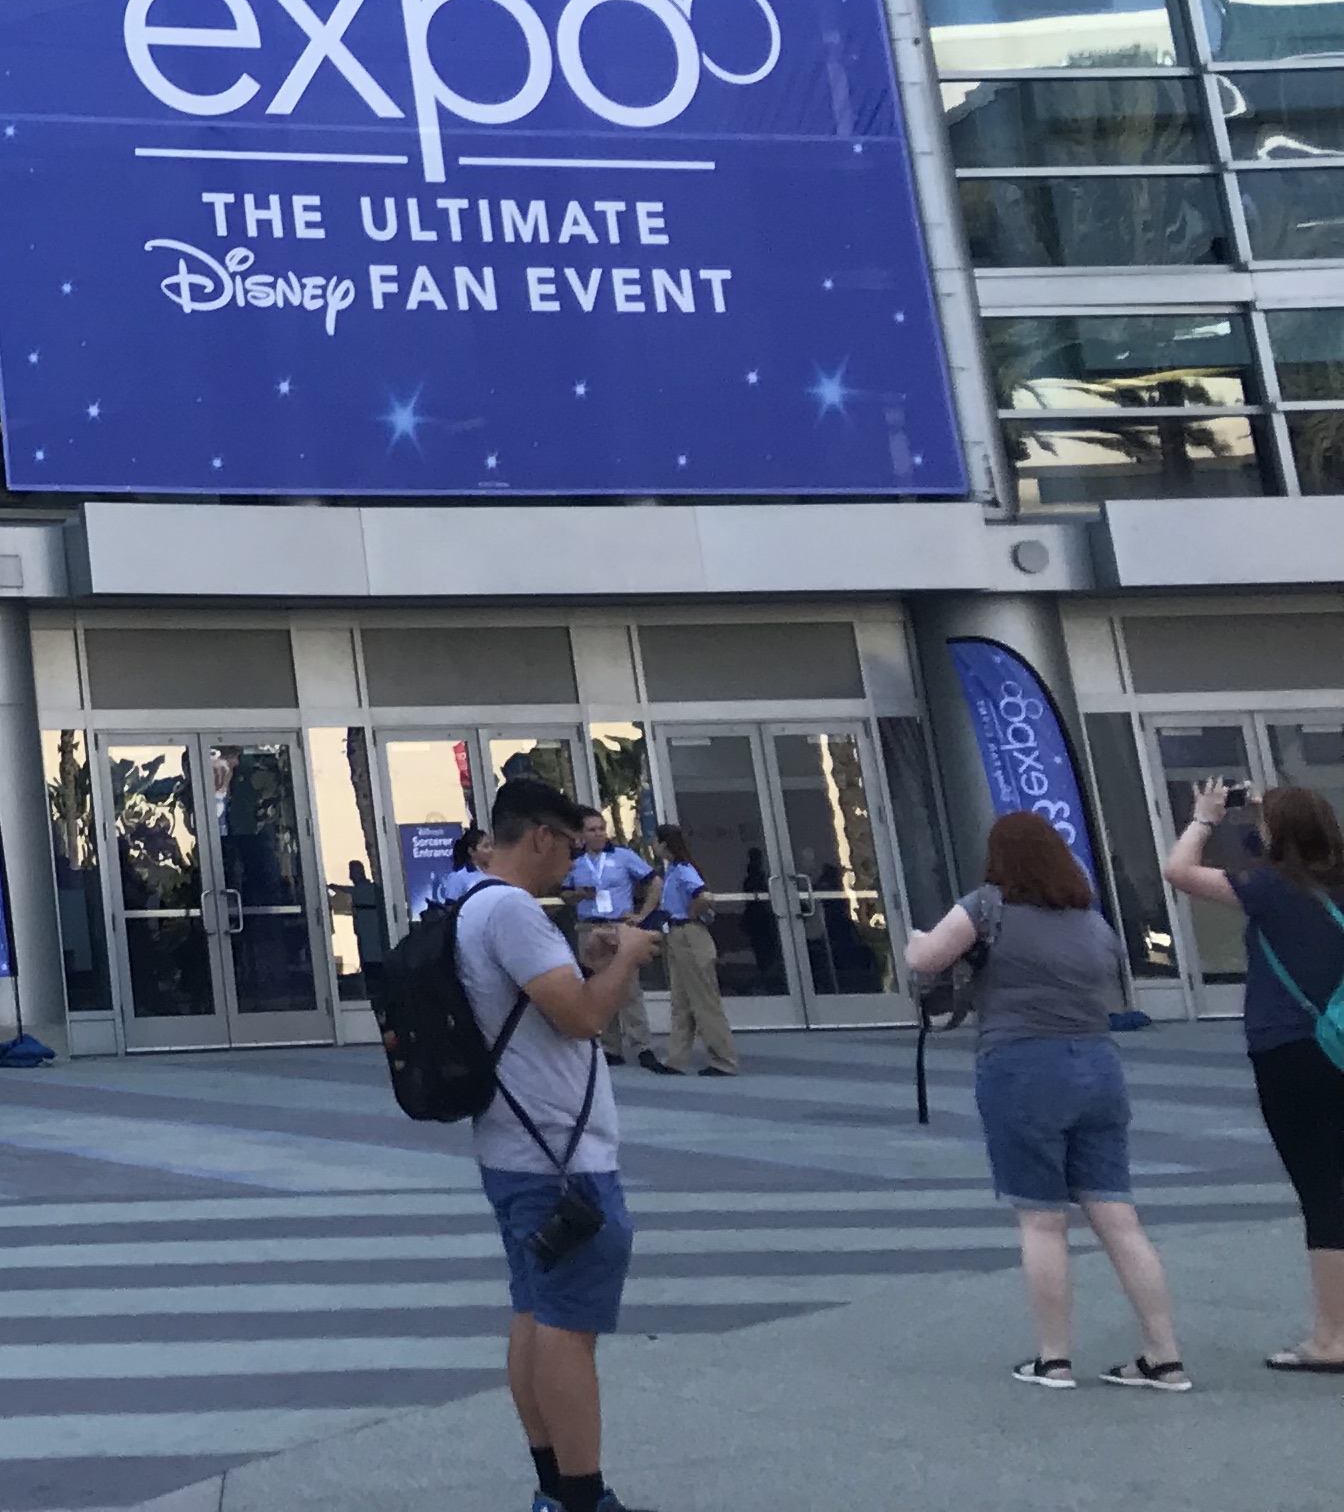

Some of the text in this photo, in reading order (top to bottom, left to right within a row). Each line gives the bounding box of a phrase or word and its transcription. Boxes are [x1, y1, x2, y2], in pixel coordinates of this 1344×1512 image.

[202, 192, 670, 245] THE ULTIMATE
[144, 239, 732, 335] Disney FAN EVENT
